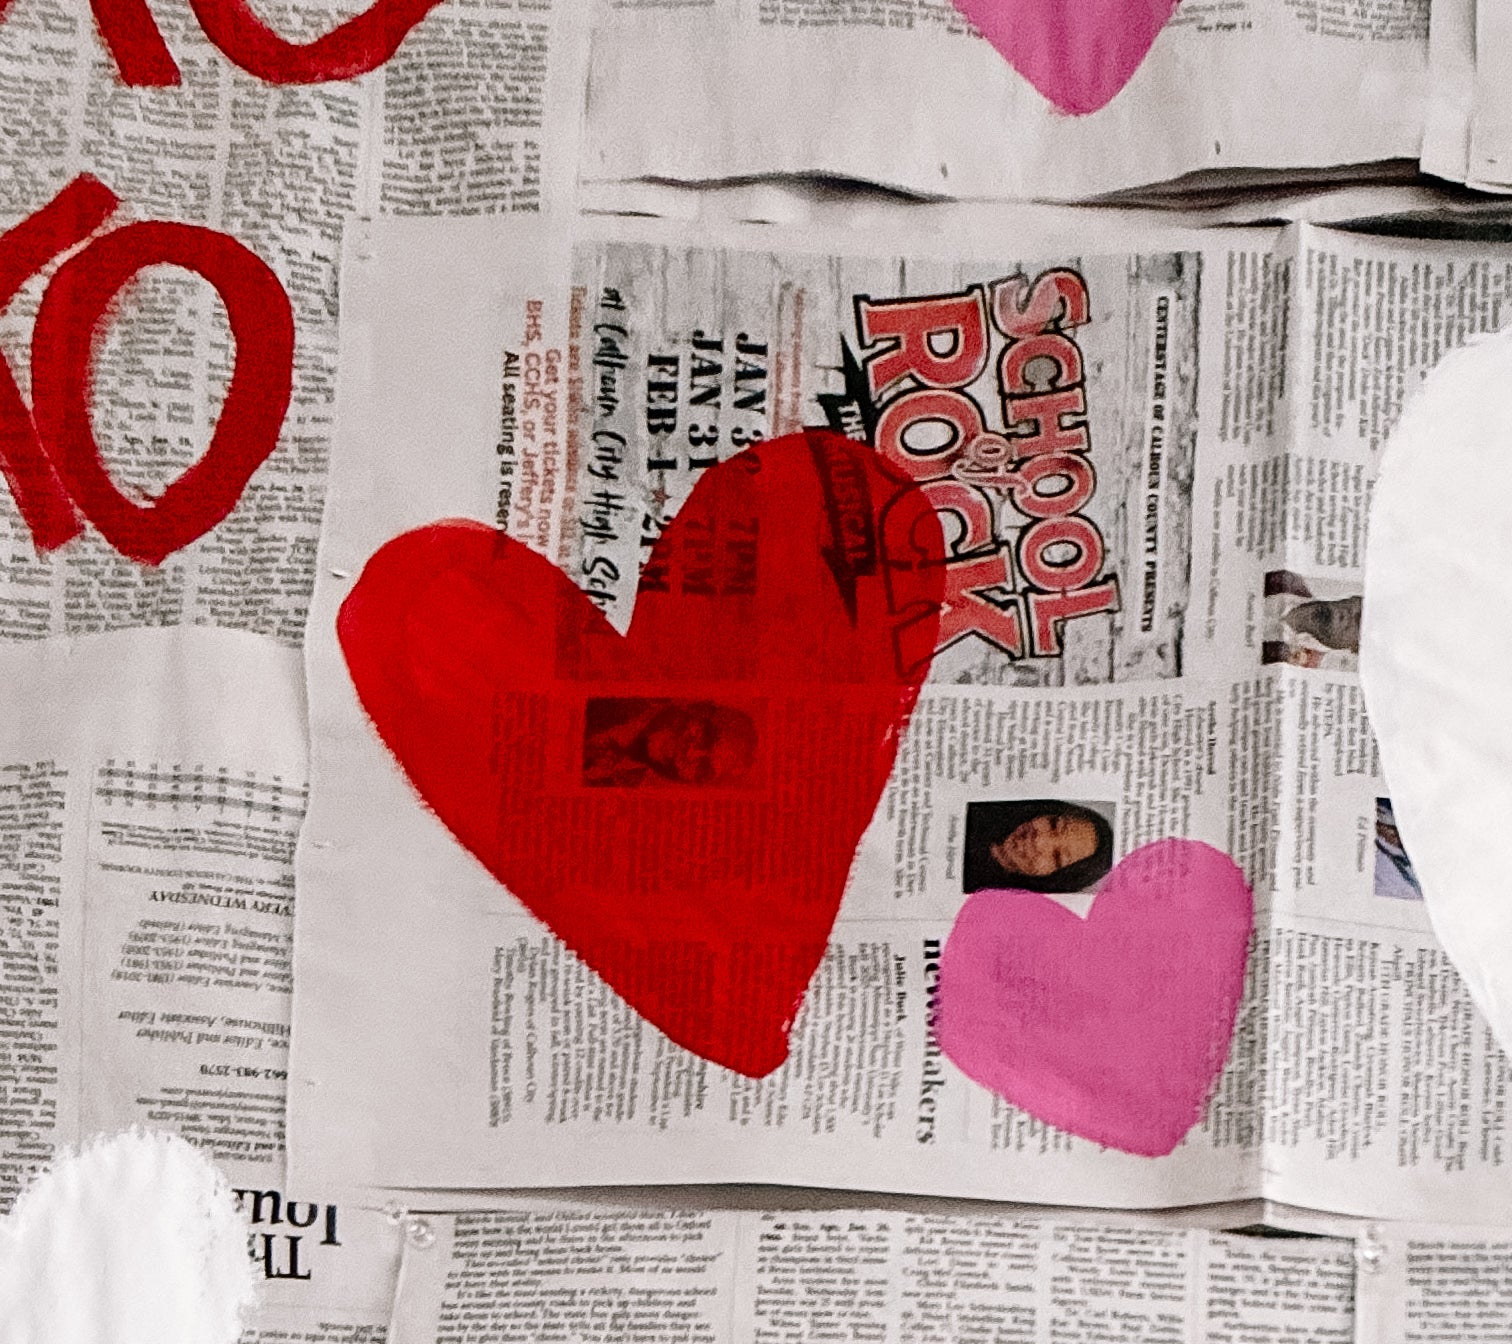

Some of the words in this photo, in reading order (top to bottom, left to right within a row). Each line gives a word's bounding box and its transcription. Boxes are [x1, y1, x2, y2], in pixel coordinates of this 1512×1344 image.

[502, 350, 521, 379] All
[646, 353, 680, 437] FEB
[689, 328, 724, 410] JAN
[732, 332, 769, 416] JAN
[496, 383, 518, 457] seating
[540, 389, 560, 437] your
[499, 460, 518, 479] is
[538, 440, 558, 506] tickets
[853, 283, 1024, 677] ROCK
[953, 431, 1033, 498] of
[988, 267, 1121, 660] SCHOOL
[1148, 421, 1165, 489] CALHOUN
[1144, 492, 1161, 556] COUNTY
[1140, 560, 1159, 633] PRESENTS
